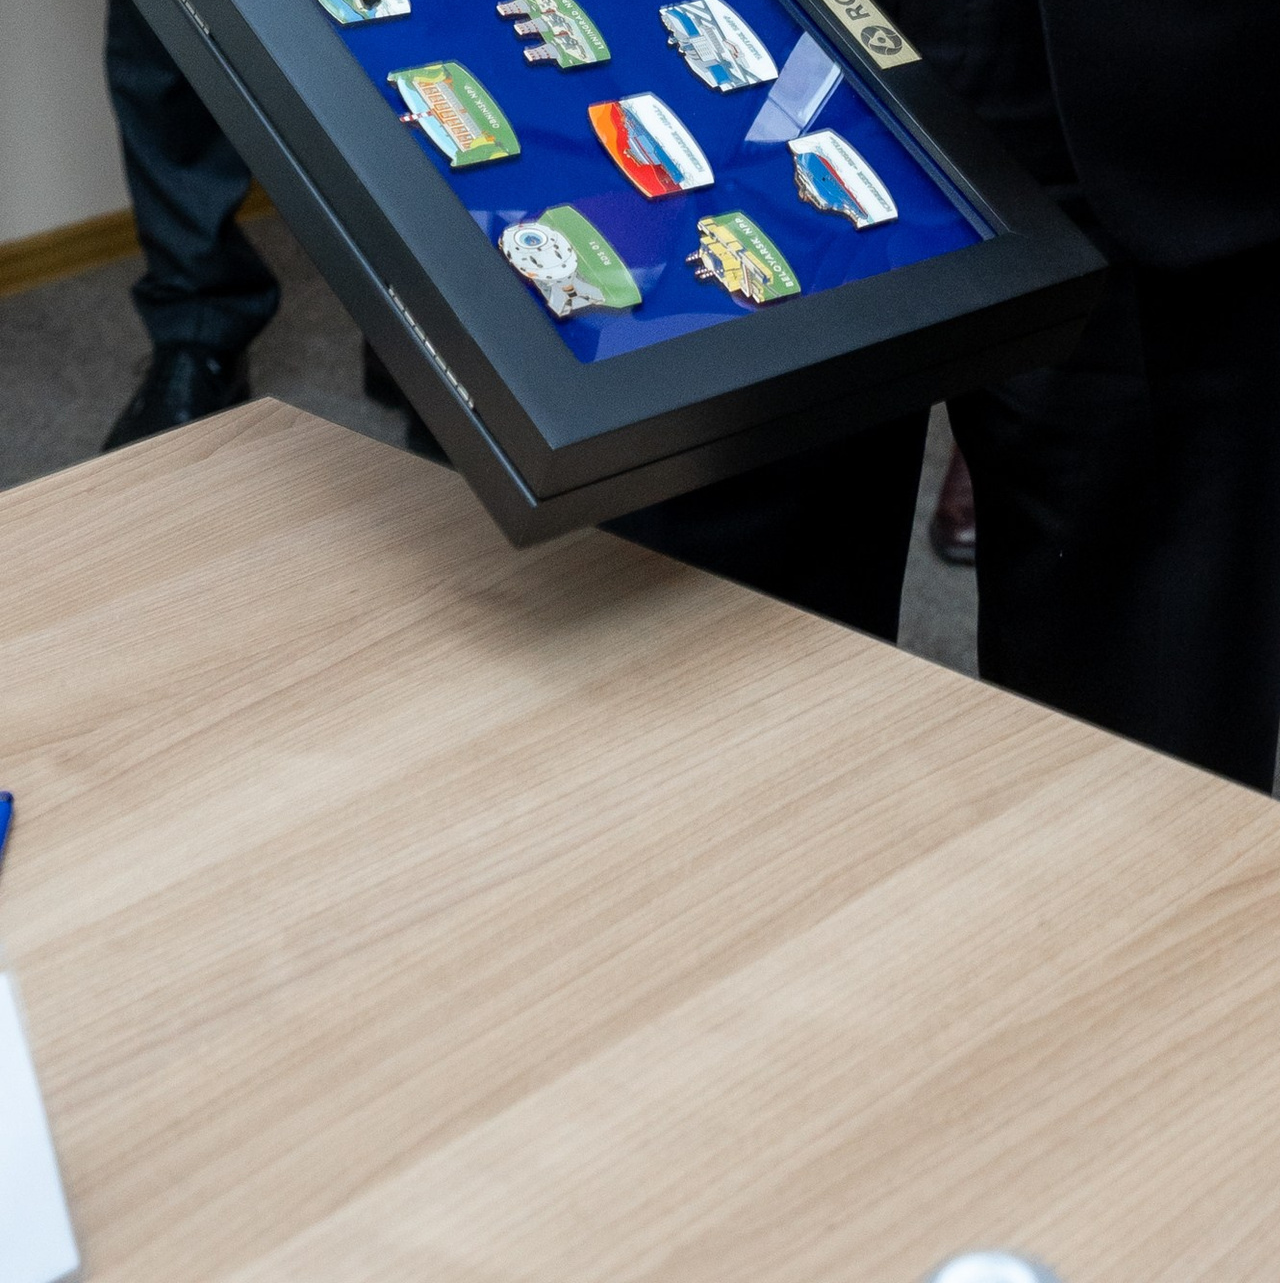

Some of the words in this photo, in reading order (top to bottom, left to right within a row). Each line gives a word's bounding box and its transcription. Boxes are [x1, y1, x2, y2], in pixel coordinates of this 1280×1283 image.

[572, 10, 605, 50] LENINGRAD
[464, 84, 478, 99] NPP
[475, 99, 500, 129] OBNINSK
[735, 217, 752, 234] NPP
[597, 251, 612, 266] RDS
[751, 237, 794, 287] BELOYARSK
